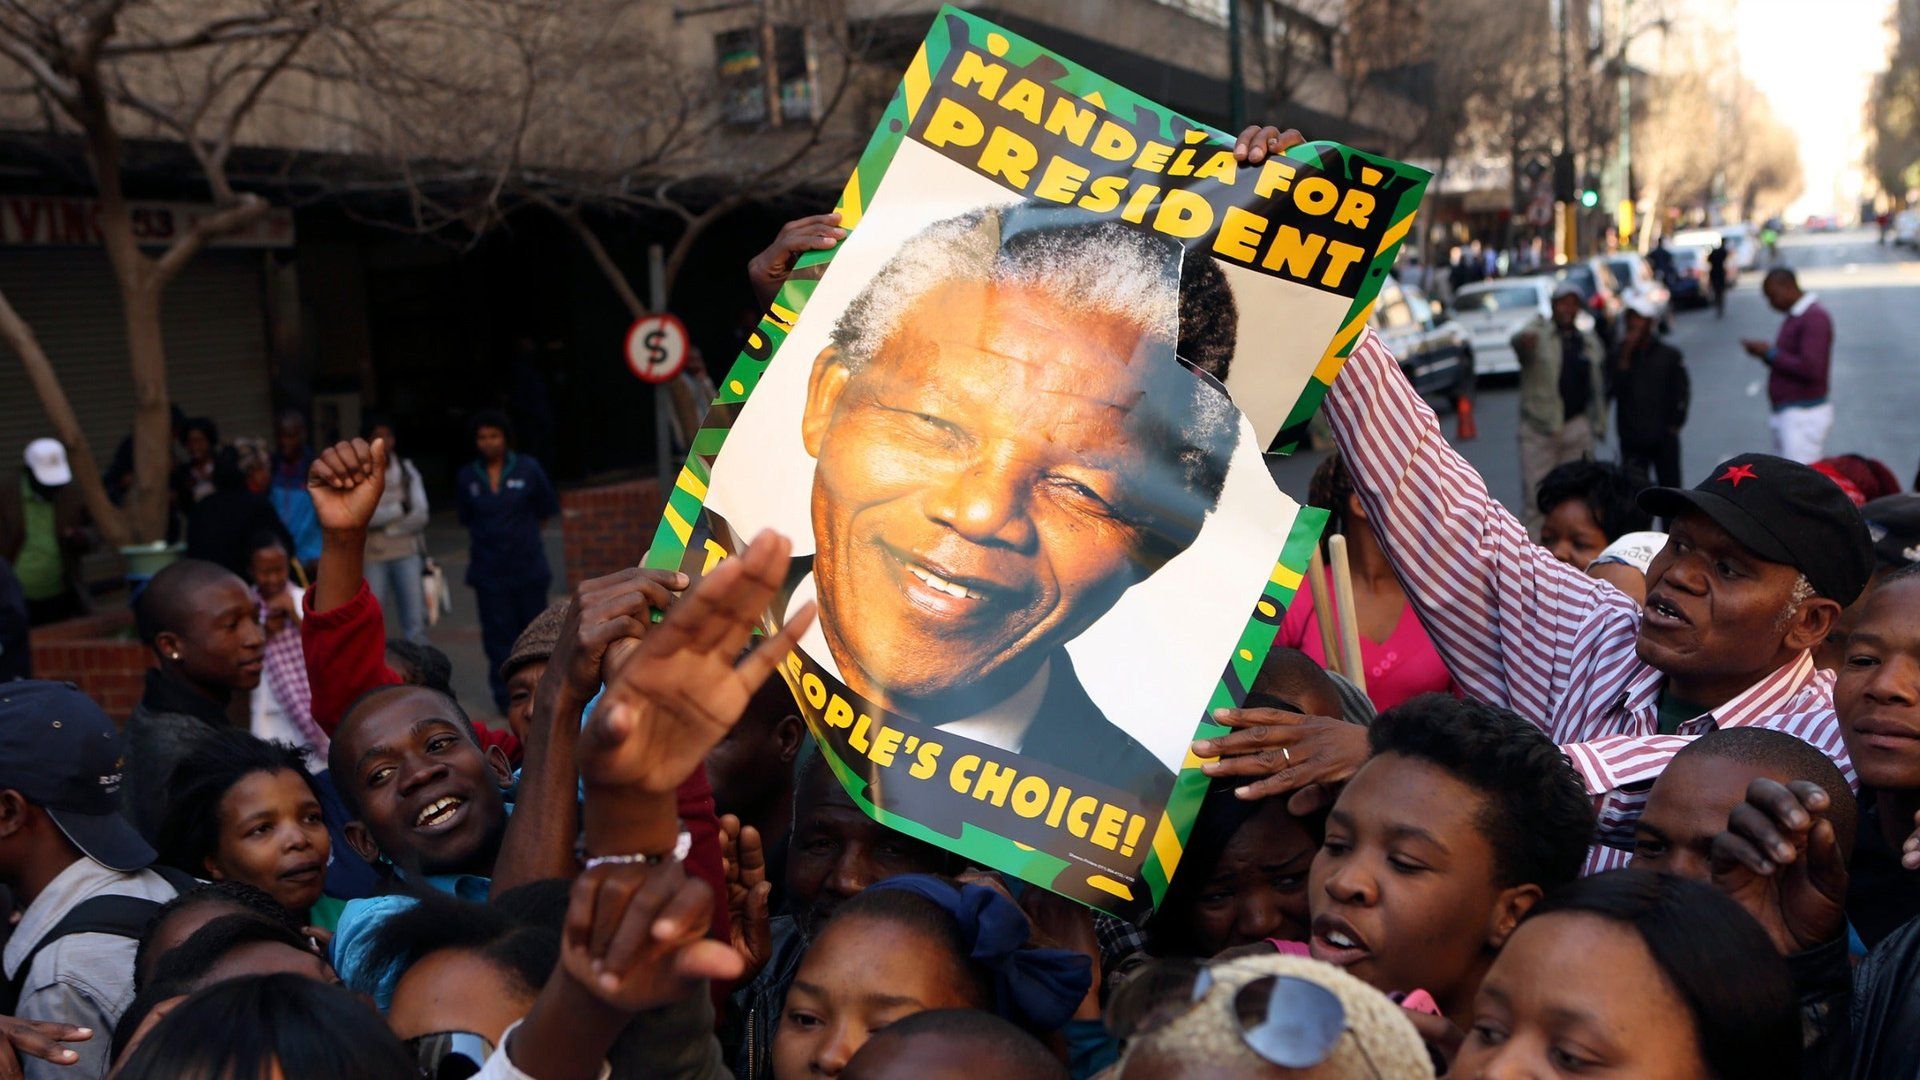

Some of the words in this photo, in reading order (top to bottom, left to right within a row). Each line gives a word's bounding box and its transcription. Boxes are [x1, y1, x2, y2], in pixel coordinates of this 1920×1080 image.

[921, 96, 1366, 289] PRESIDENT
[951, 49, 1239, 185] MANDELA
[1253, 159, 1377, 231] FOR
[785, 648, 943, 781] EOPLE'S
[948, 754, 1147, 858] CHOICE!
